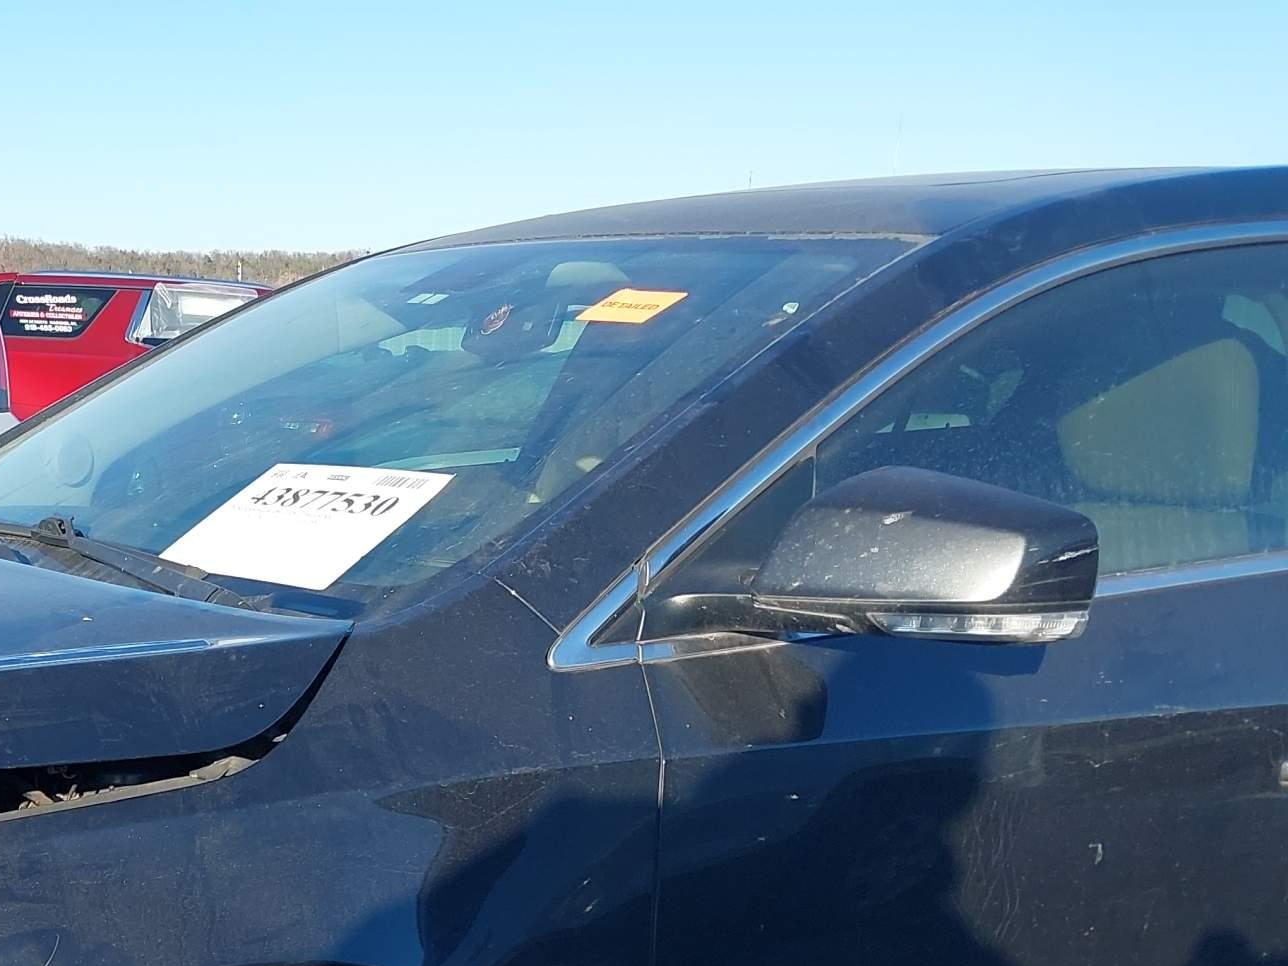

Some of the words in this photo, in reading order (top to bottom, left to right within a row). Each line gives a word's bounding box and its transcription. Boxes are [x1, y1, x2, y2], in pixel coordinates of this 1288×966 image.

[15, 294, 77, 304] CrossRoads
[601, 301, 660, 310] DETAILED
[250, 486, 400, 517] 43877530
